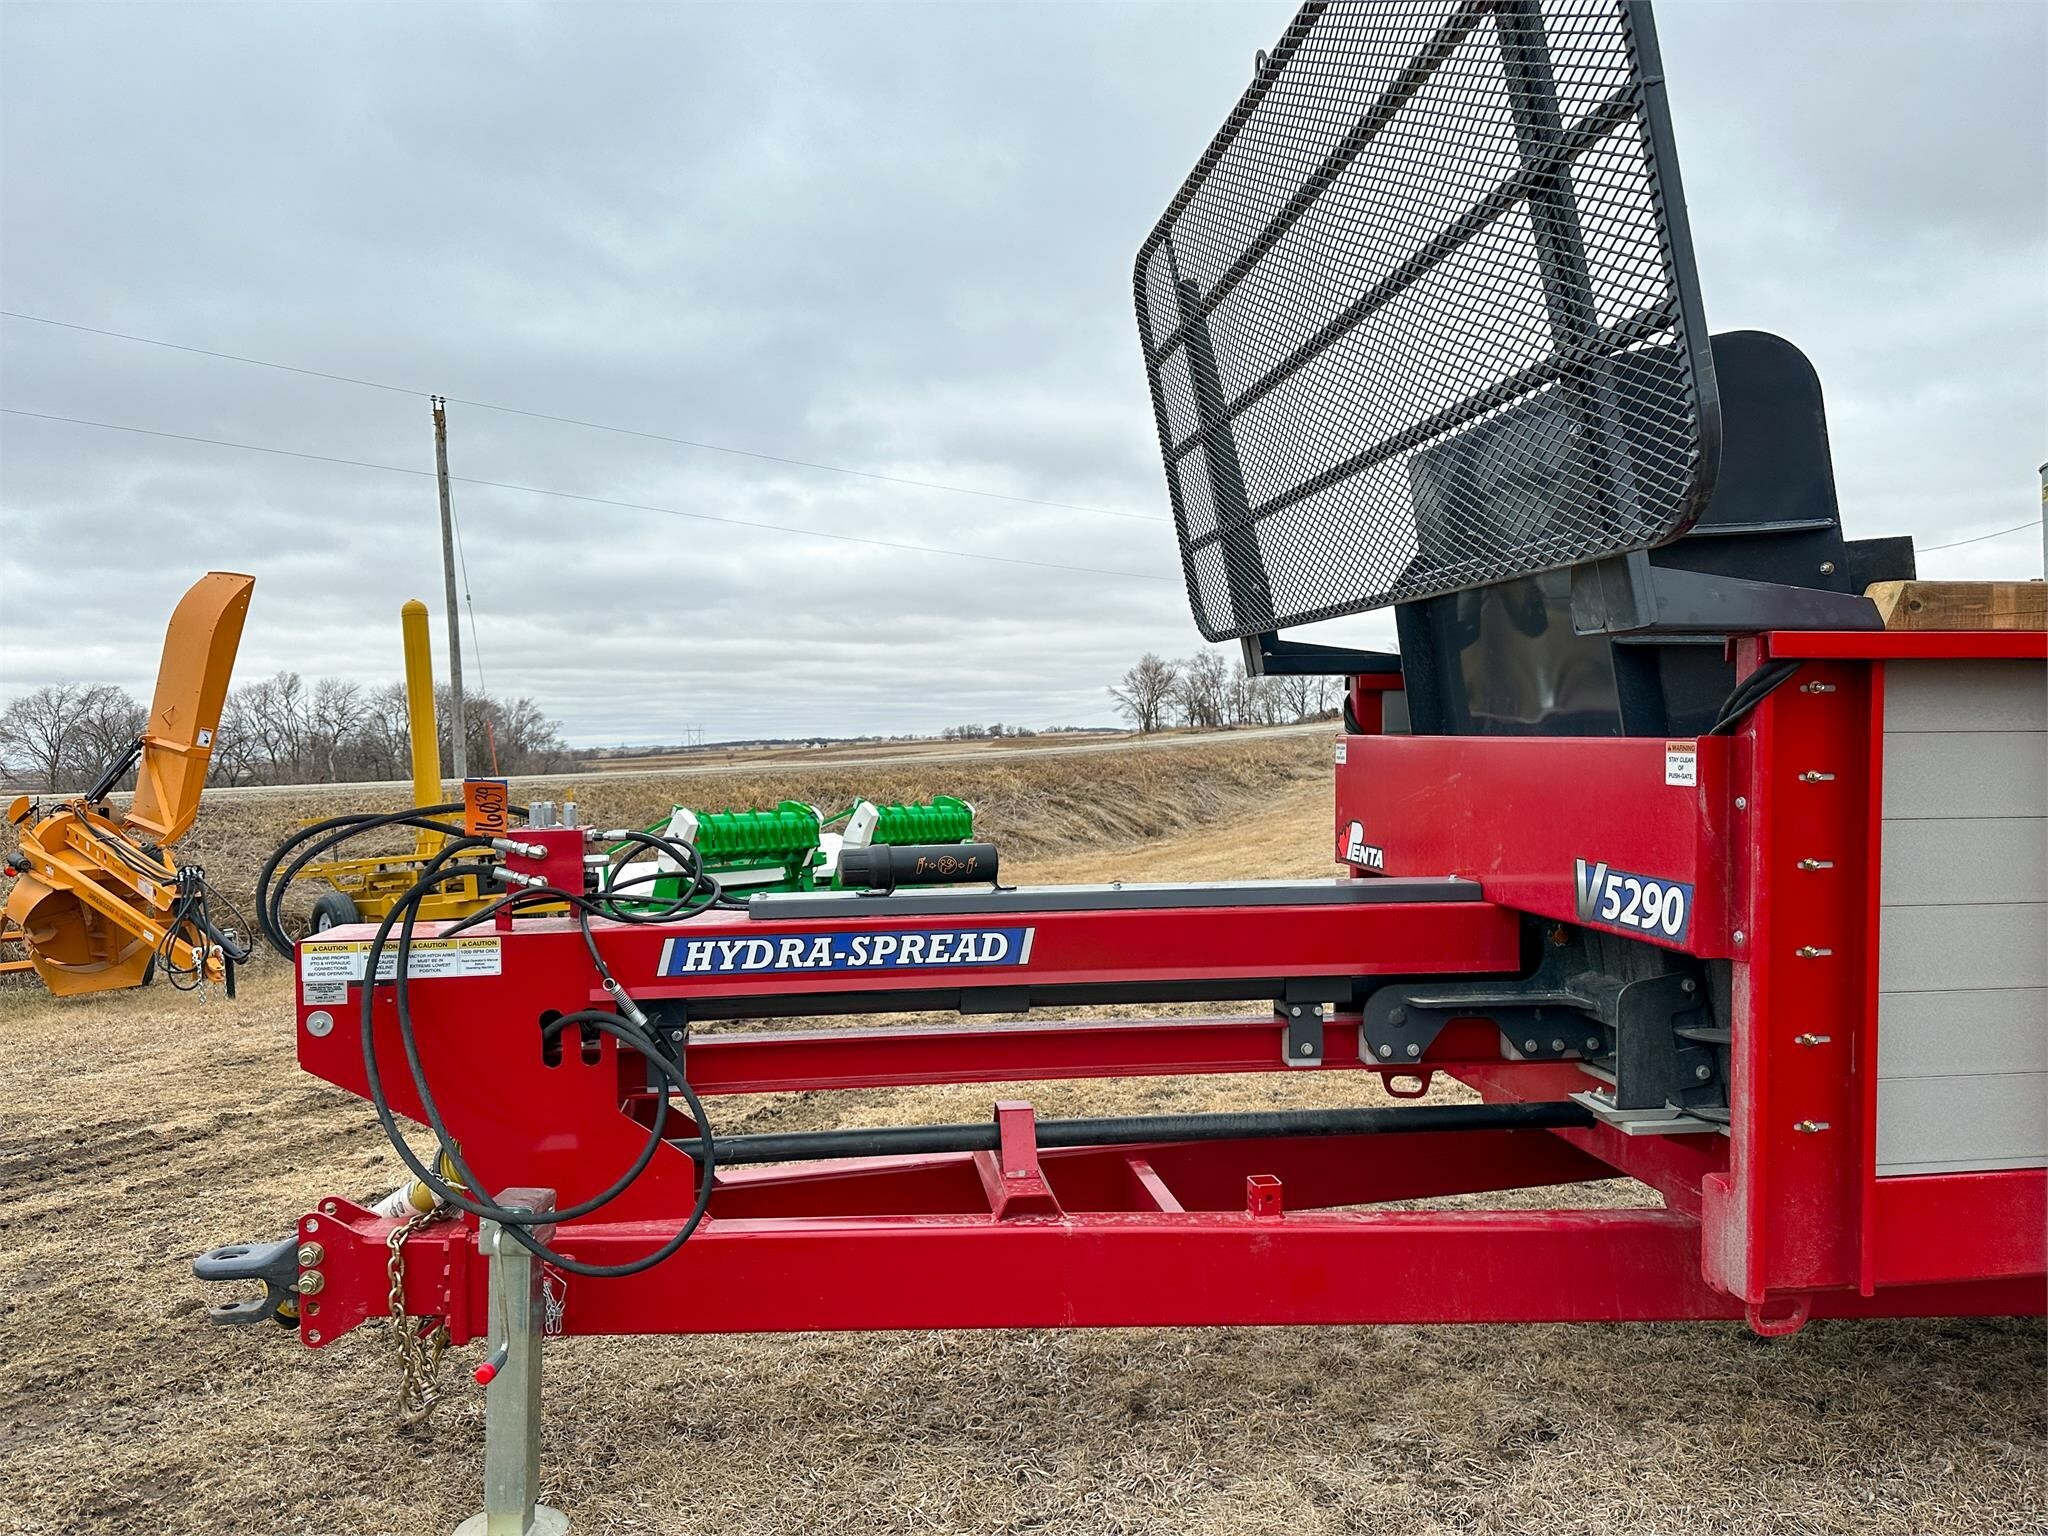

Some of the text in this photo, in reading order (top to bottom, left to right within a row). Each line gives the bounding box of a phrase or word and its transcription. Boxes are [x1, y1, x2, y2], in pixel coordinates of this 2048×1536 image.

[1346, 821, 1384, 868] PENTA
[1576, 858, 1685, 936] V5290
[682, 932, 1009, 971] HYDRA-SPREAD
